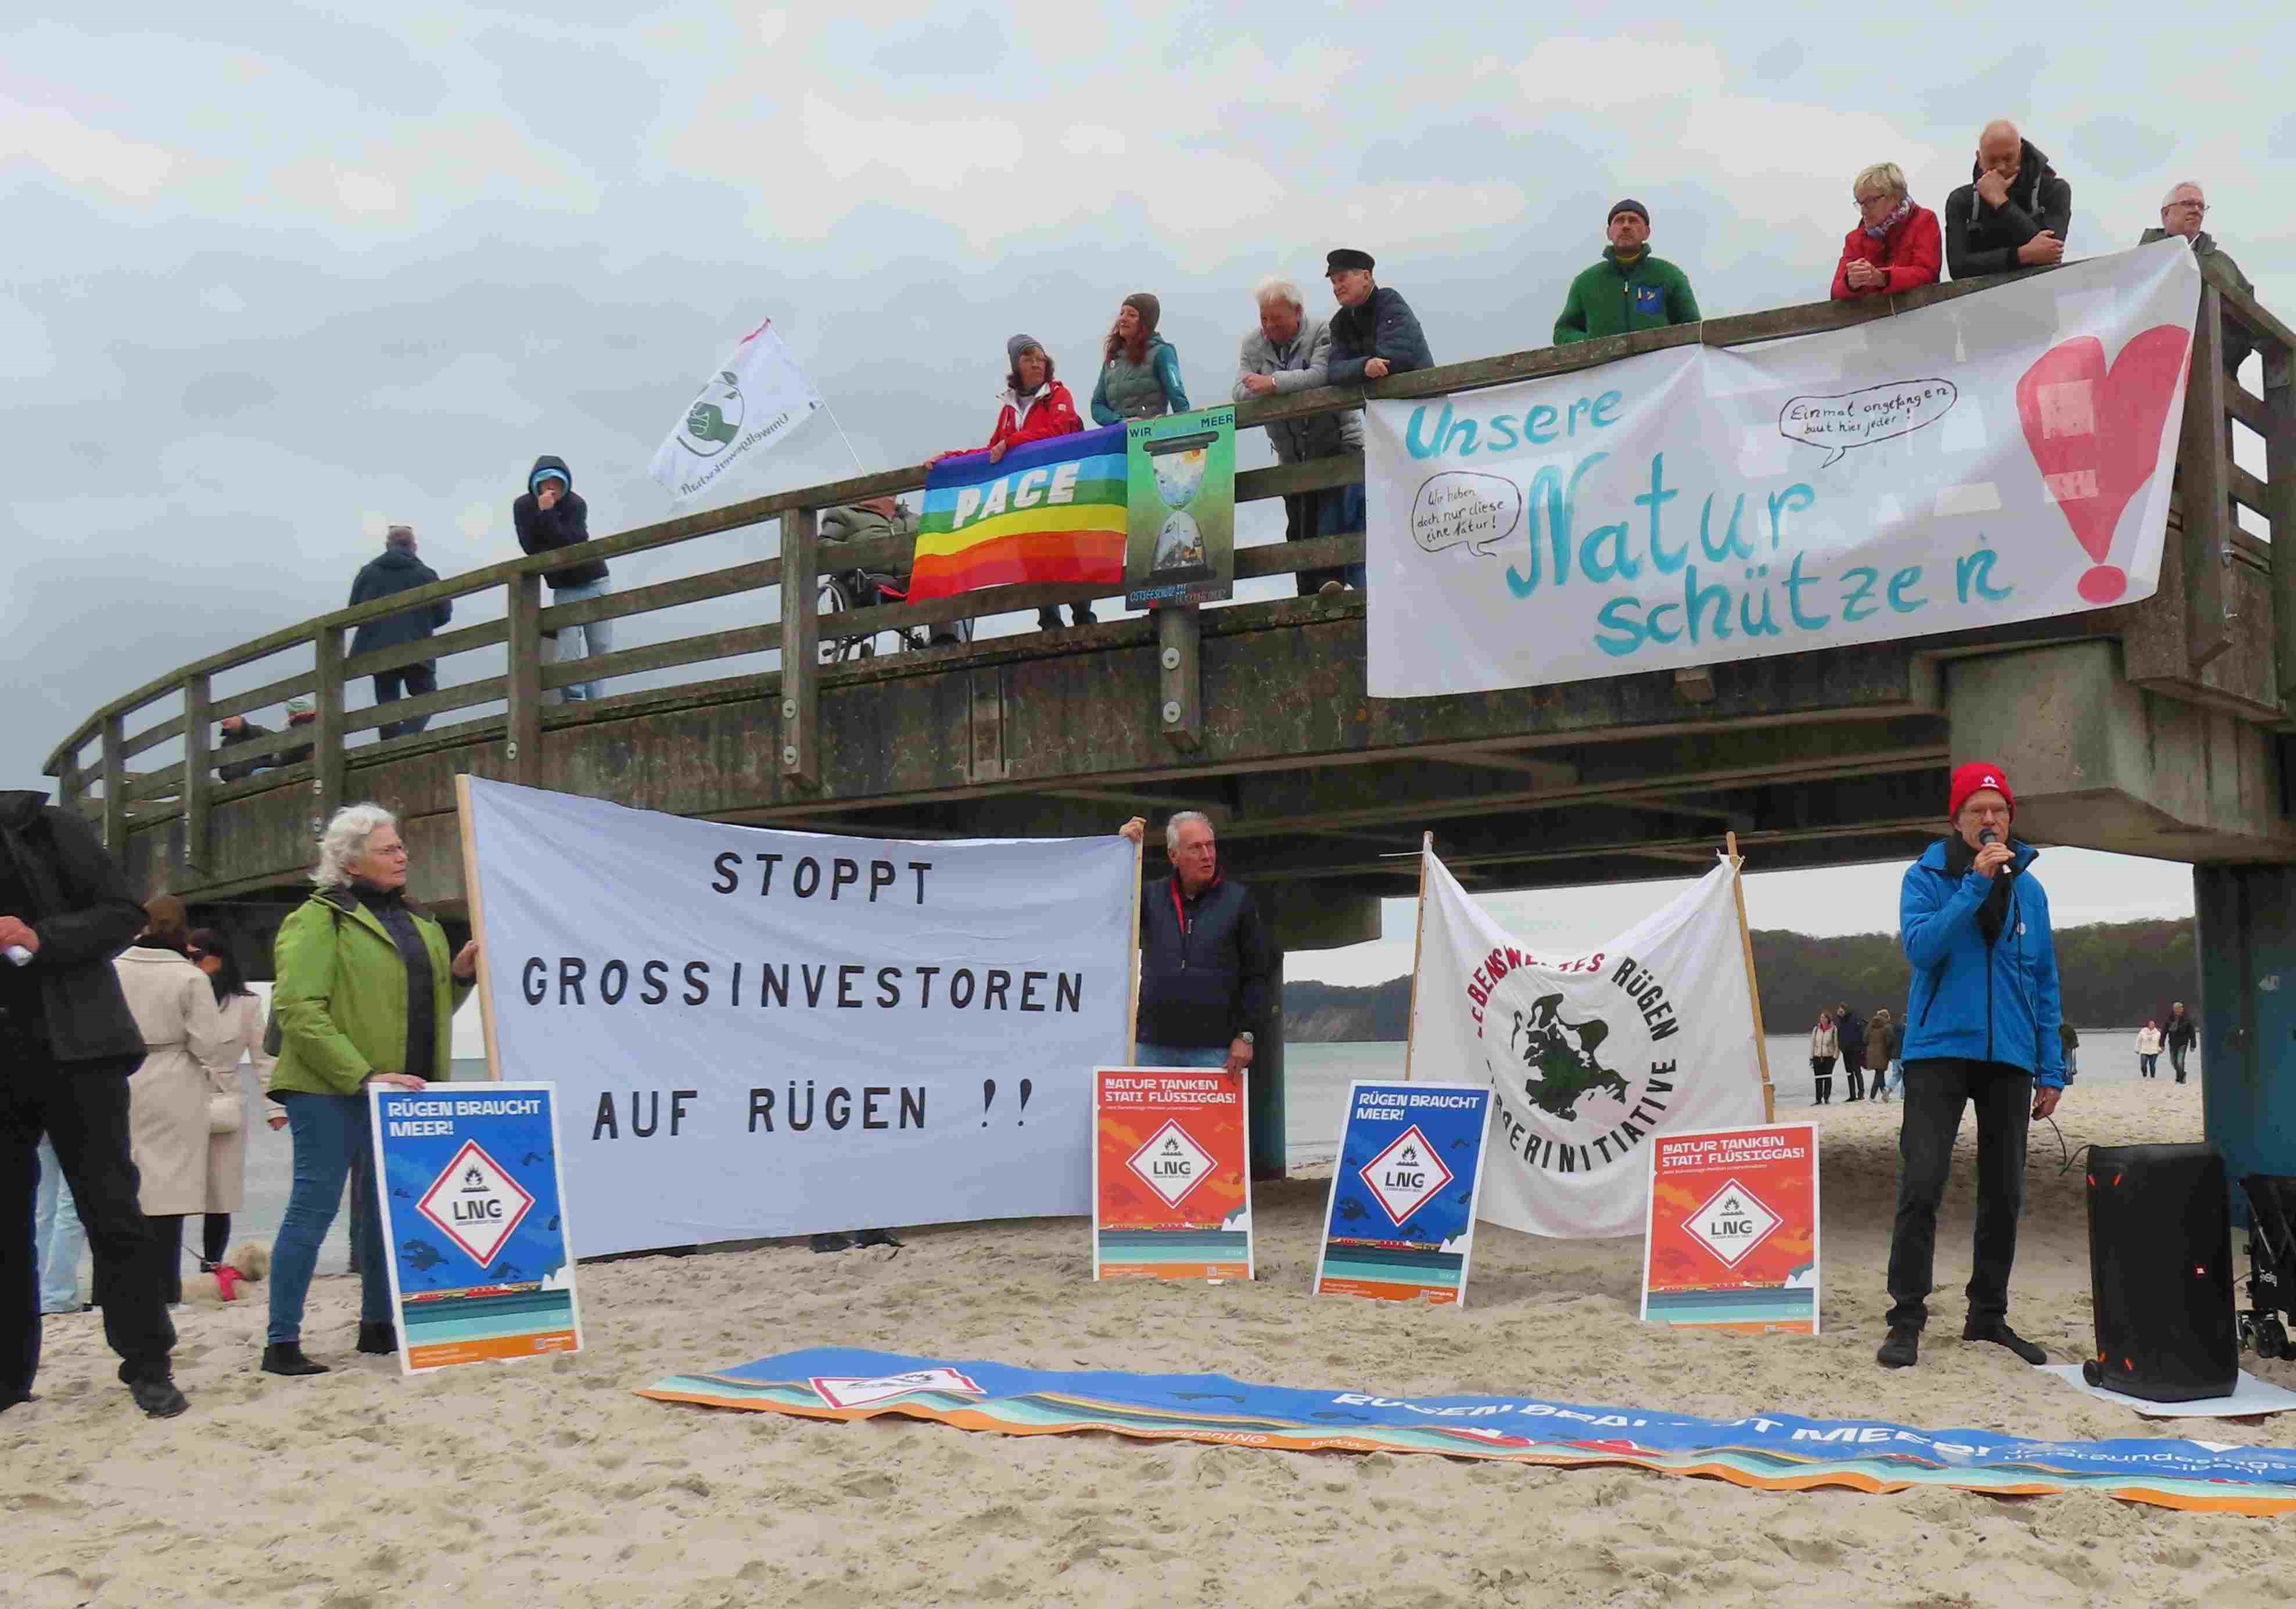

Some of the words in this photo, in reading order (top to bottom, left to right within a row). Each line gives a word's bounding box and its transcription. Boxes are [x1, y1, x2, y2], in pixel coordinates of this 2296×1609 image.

[1790, 401, 1854, 420] Einmal
[1864, 387, 1949, 414] angefangen
[1129, 427, 1152, 438] WIR
[1200, 413, 1233, 428] MEER
[1405, 390, 1624, 460] Unsere
[1839, 421, 1862, 432] hier
[953, 463, 1081, 529] PACE
[1427, 489, 1443, 506] Wir
[1447, 486, 1477, 503] haben
[1417, 513, 1440, 528] doch
[1444, 507, 1466, 521] nur
[1506, 451, 1814, 599] Natur
[1427, 528, 1451, 543] eine
[1591, 547, 2013, 657] schützen
[712, 851, 932, 904] STOPPT
[523, 957, 1082, 1012] GROSSINVESTOREN
[1611, 956, 1679, 1042] RÜGEN
[1106, 1078, 1157, 1090] NATUR
[1159, 1079, 1218, 1090] TANKEN
[1106, 1091, 1143, 1102] STATT
[1148, 1090, 1236, 1103] FLÜSSIGGAS!
[1358, 1091, 1408, 1106] RÜGEN
[1409, 1094, 1479, 1109] BRAUCHT
[388, 1098, 454, 1118] RÜGEN
[456, 1099, 541, 1116] BRAUCHT
[592, 1090, 698, 1139] AUF
[748, 1080, 925, 1132] RÜGEN
[1356, 1108, 1405, 1121] MEER!
[389, 1120, 454, 1137] MEER!
[1663, 1141, 1717, 1155] NATUR
[1719, 1135, 1785, 1150] TANKEN
[1662, 1154, 1703, 1167] STATT
[1708, 1147, 1804, 1164] FLÜSSIGGAS!
[1153, 1161, 1190, 1174] LNG
[1385, 1171, 1425, 1188] LNG
[453, 1198, 503, 1220] LNG
[1710, 1220, 1753, 1235] LNG
